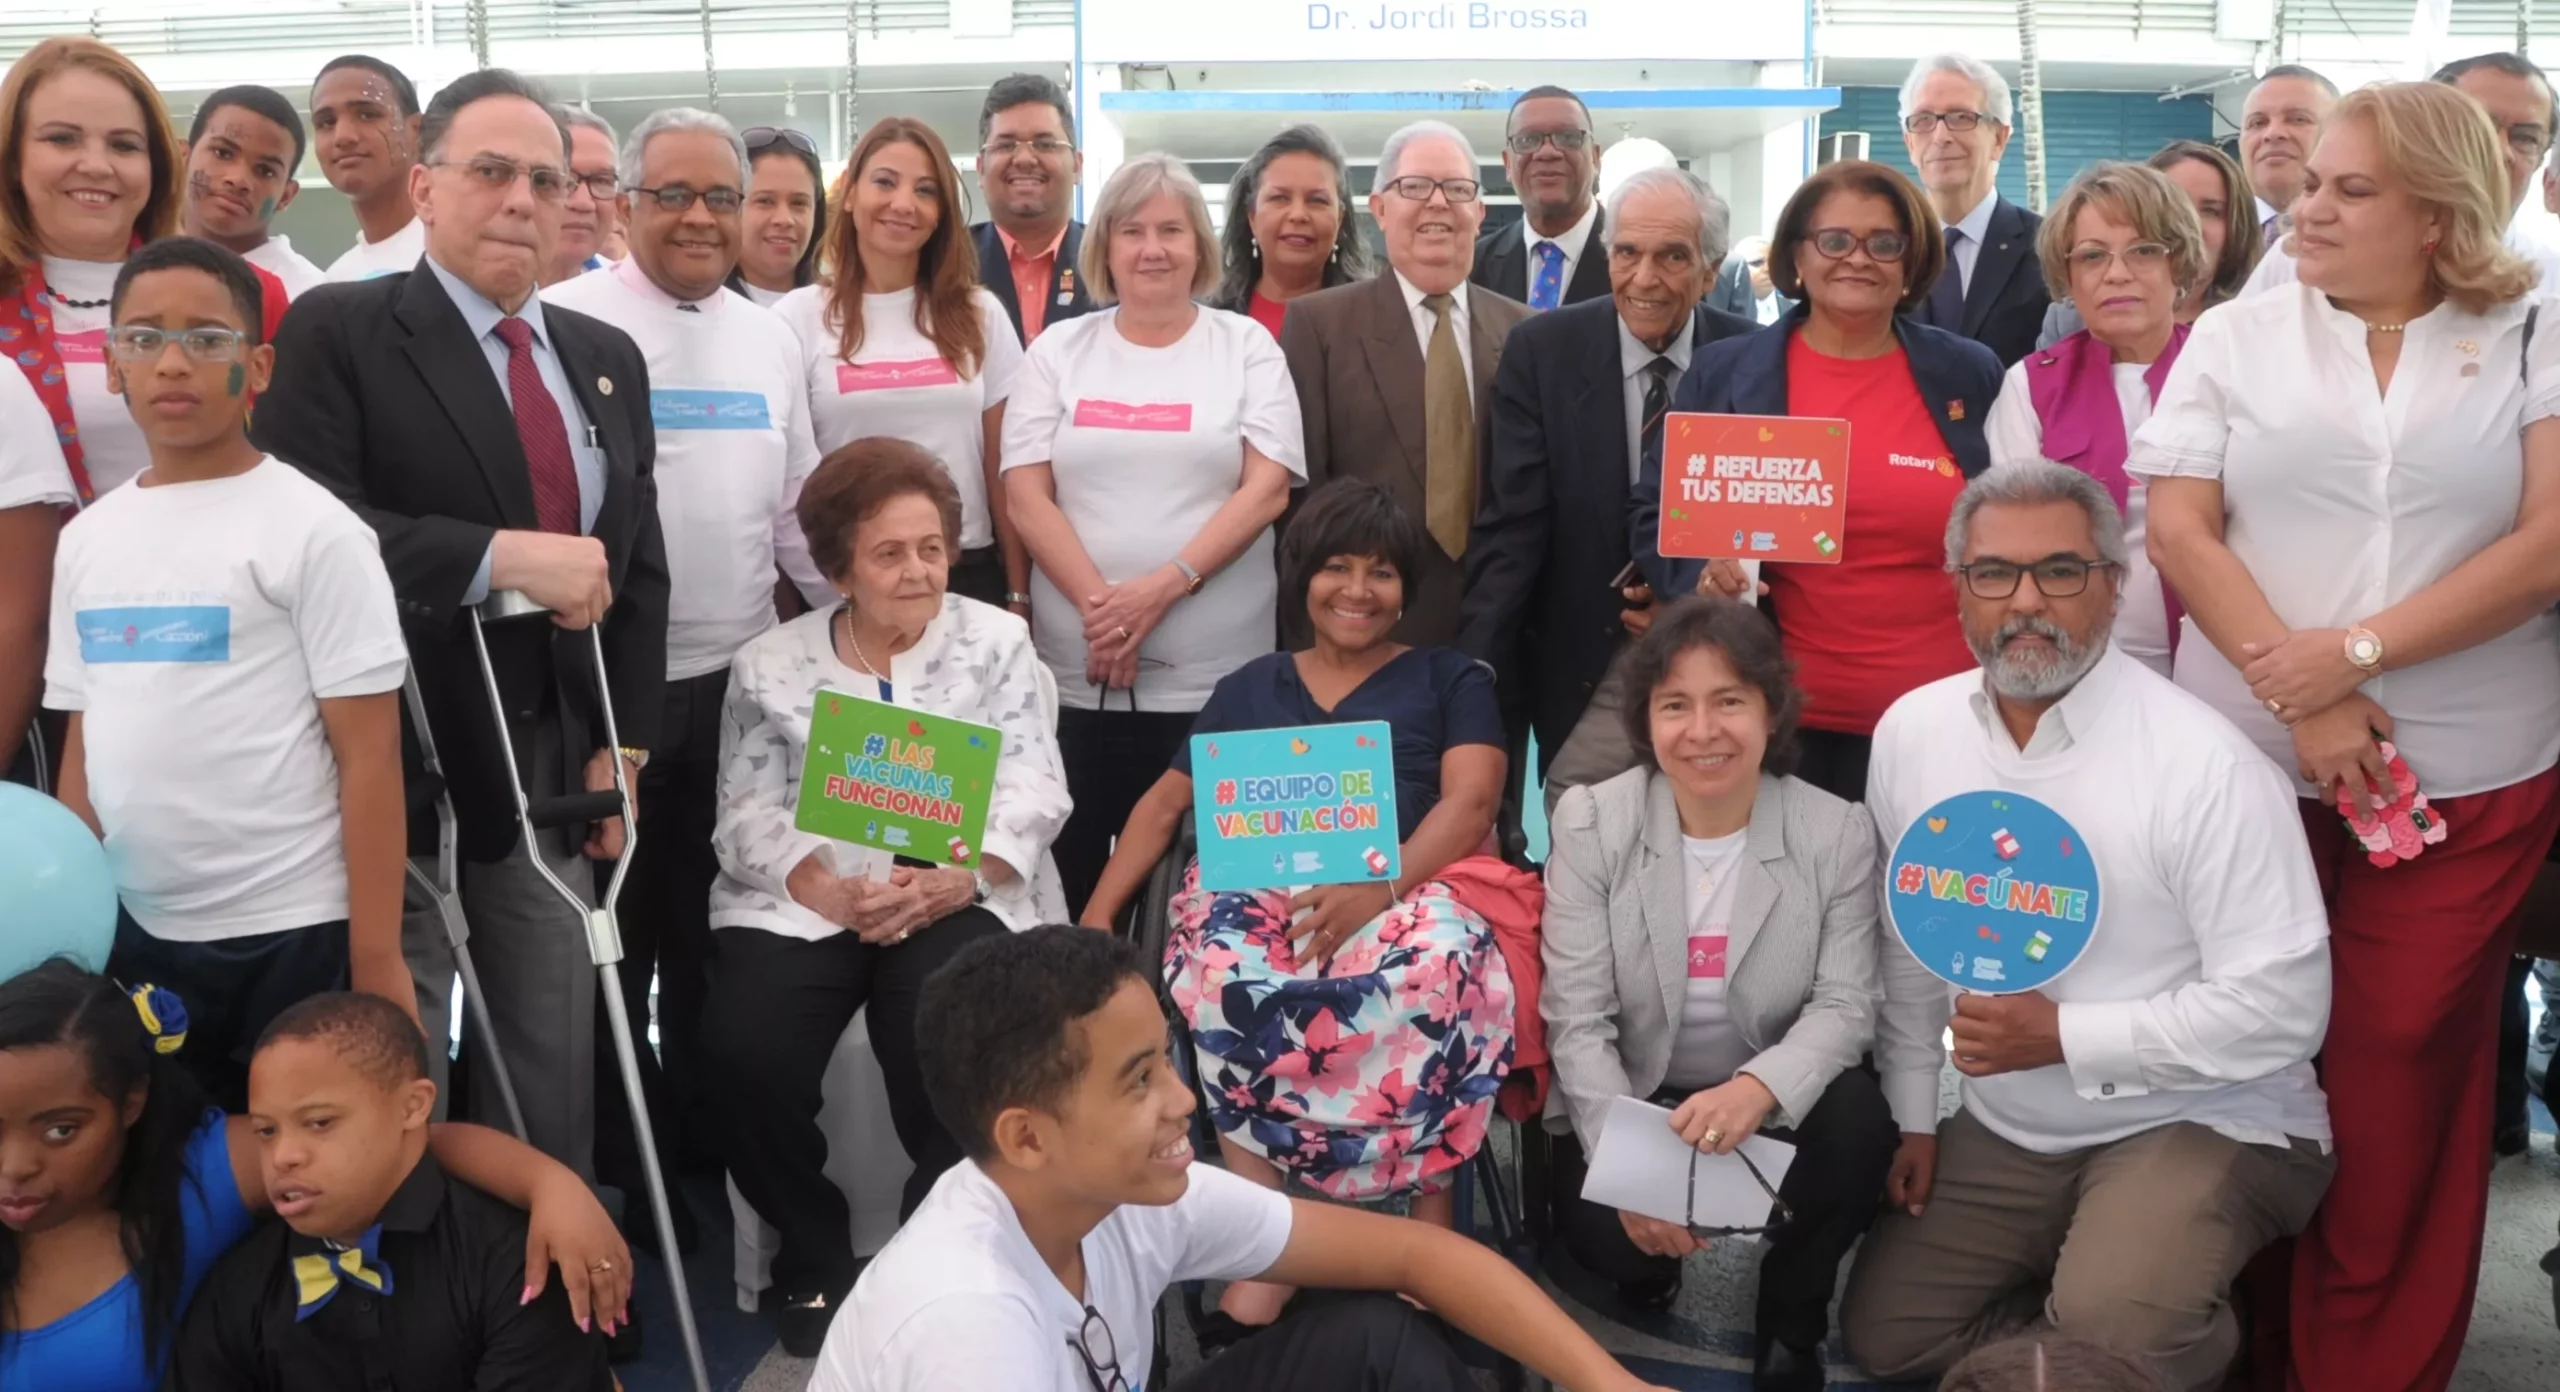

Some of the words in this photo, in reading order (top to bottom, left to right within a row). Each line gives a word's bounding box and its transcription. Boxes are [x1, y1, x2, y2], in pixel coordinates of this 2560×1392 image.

[1307, 3, 1356, 30] Dr.
[1369, 2, 1455, 30] Jordi
[1469, 2, 1588, 29] Brossa
[1713, 455, 1823, 482] REFUERZA
[1889, 453, 1935, 470] Rotary
[1680, 479, 1721, 502] TUS
[1727, 480, 1833, 507] DEFENSAS
[889, 738, 936, 769] LAS
[844, 752, 953, 799] VACUNAS
[1243, 773, 1335, 803] EQUIPO
[1340, 770, 1373, 797] DE
[825, 775, 963, 826] FUNCIONAN
[1214, 799, 1379, 839] VACUNACIÓN
